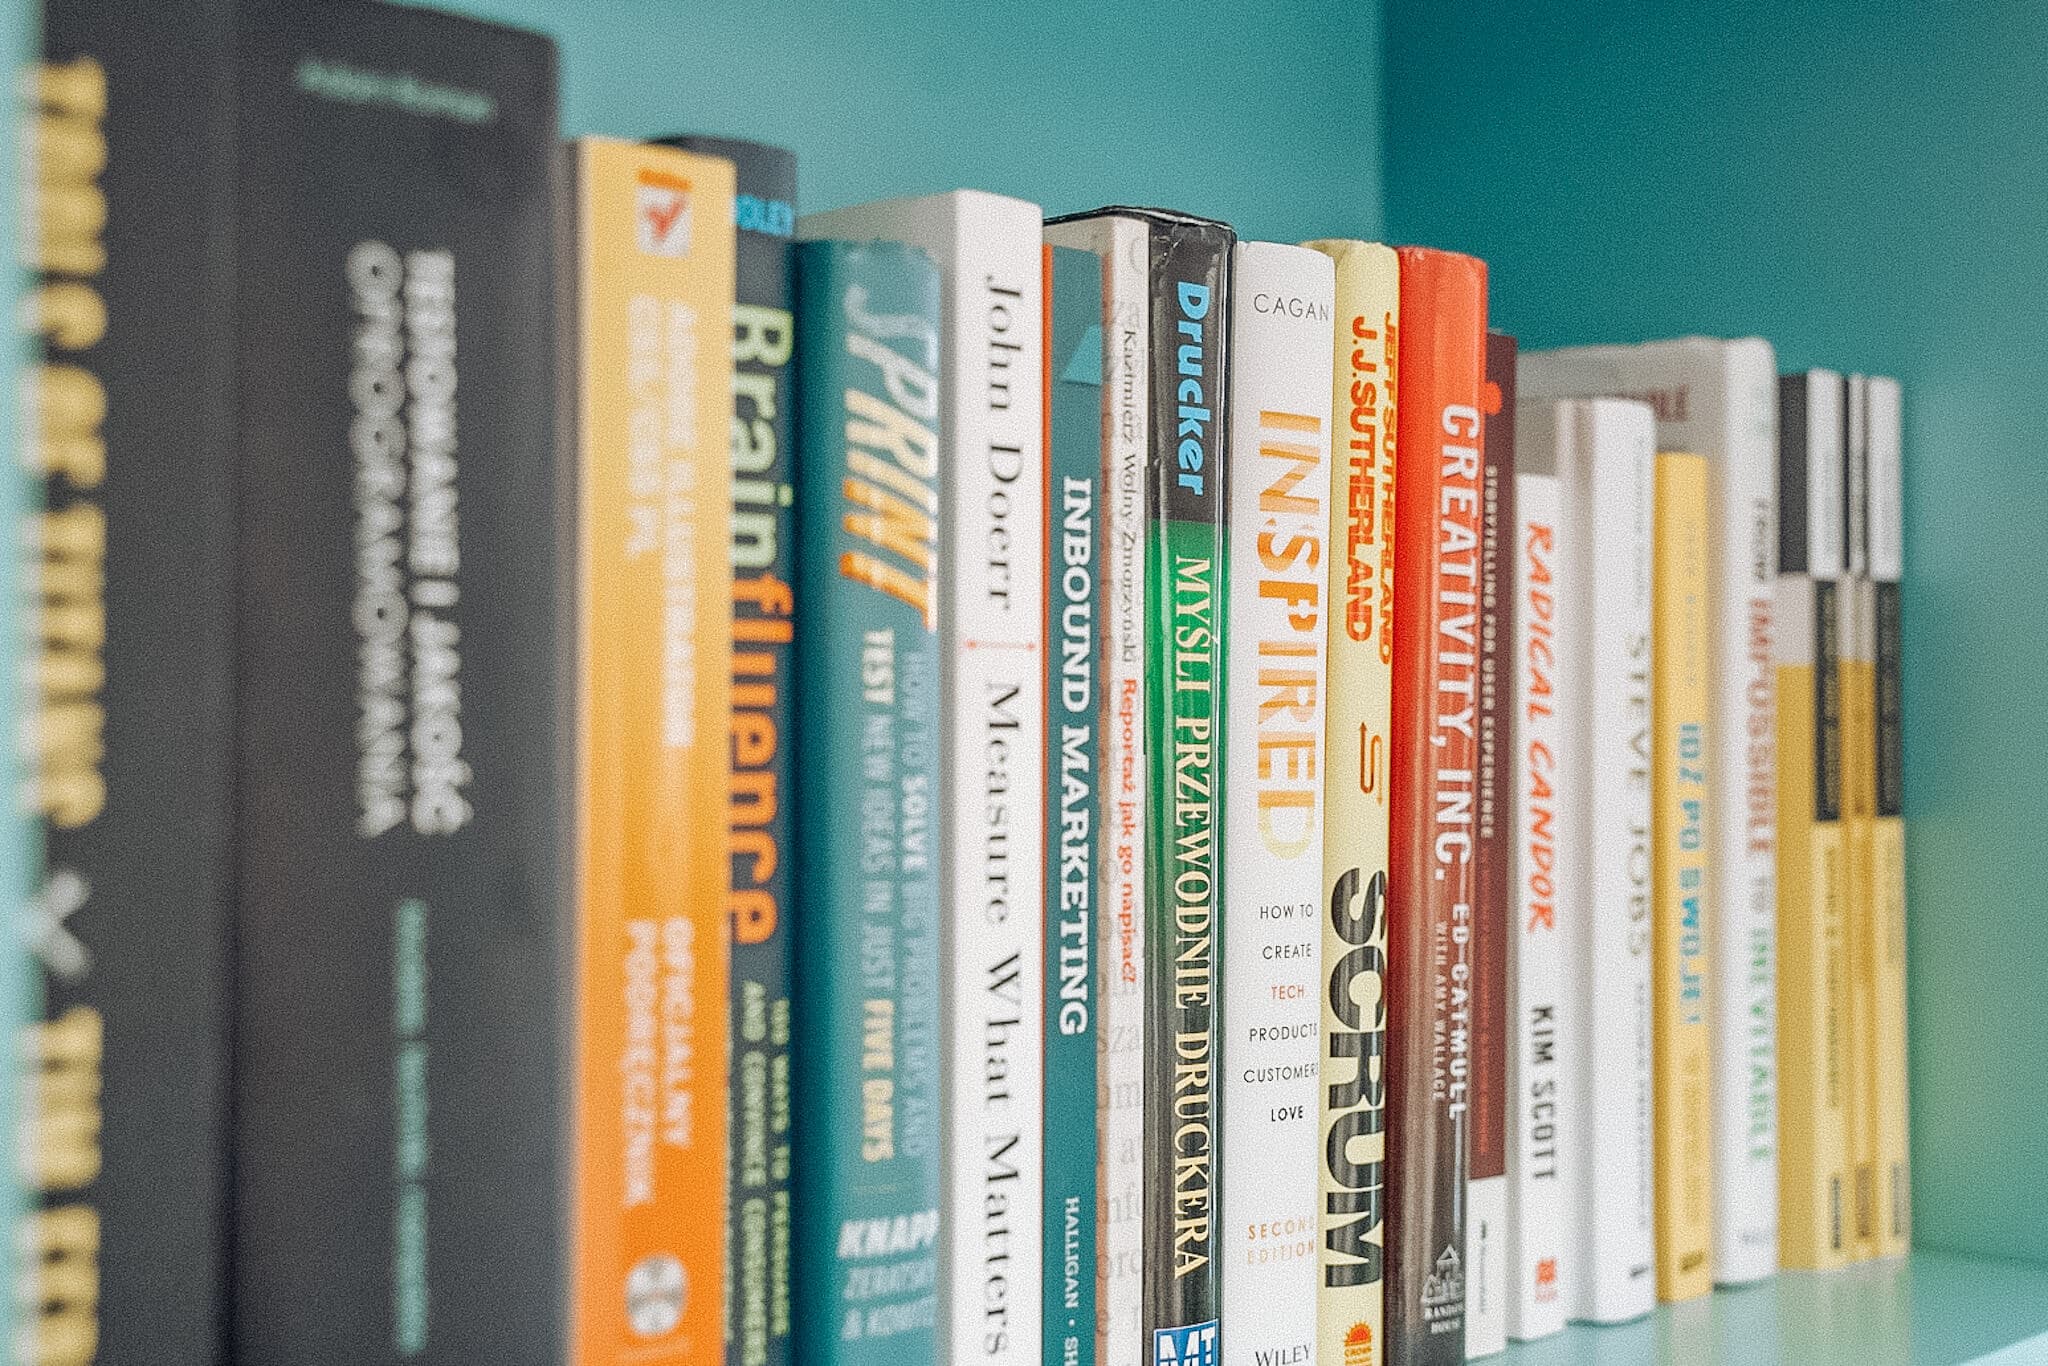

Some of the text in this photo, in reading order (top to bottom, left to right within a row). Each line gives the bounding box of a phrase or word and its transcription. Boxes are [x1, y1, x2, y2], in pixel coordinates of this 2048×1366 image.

[1253, 292, 1330, 321] CAGAN
[1121, 330, 1139, 445] Kazimierz
[1177, 280, 1212, 497] Drucker
[840, 284, 939, 631] SPRINT
[1378, 311, 1397, 665] JEFF SUTHERLAND
[1482, 464, 1499, 609] STORYTELLING
[732, 303, 794, 944] Brainfluence
[862, 629, 895, 706] TEST
[1256, 409, 1323, 861] INSPIRED
[1429, 403, 1481, 883] CREATIVITY, INC.
[1481, 614, 1497, 654] FOR
[1120, 678, 1138, 794] Reportaż
[1480, 659, 1497, 711] USER
[1526, 522, 1556, 935] RADICAL CANDOR
[1626, 632, 1651, 792] STEVE
[1059, 476, 1092, 1035] INBOUND MARKETING
[1479, 716, 1495, 840] EXPERIENCE
[901, 774, 928, 872] SOLVE
[984, 273, 1024, 1357] John Doerr Measure What Matters
[1118, 801, 1138, 838] jak
[1118, 845, 1134, 875] go
[1677, 799, 1704, 851] PO
[1174, 555, 1220, 1280] MYŚLI PRZEWODNIE DRUCKERA
[1260, 903, 1314, 920] HOW TO
[1627, 821, 1652, 960] JOBS
[1262, 943, 1313, 960] CREATE
[1271, 984, 1306, 1000] TECH
[862, 998, 894, 1070] FIVE
[1249, 1022, 1319, 1042] PRODUCTS
[1430, 921, 1448, 1101] WITH AMY WALLACE
[1447, 902, 1470, 1120] ED CATMULL
[861, 1079, 894, 1161] DAYS
[1271, 1105, 1304, 1122] LOVE
[1325, 867, 1388, 1288] SCRUM
[1530, 1005, 1557, 1182] KIM SCOTT
[1063, 1196, 1080, 1309] HALLIGAN
[1247, 1239, 1315, 1265] EDITION
[1255, 1343, 1313, 1366] WILEY
